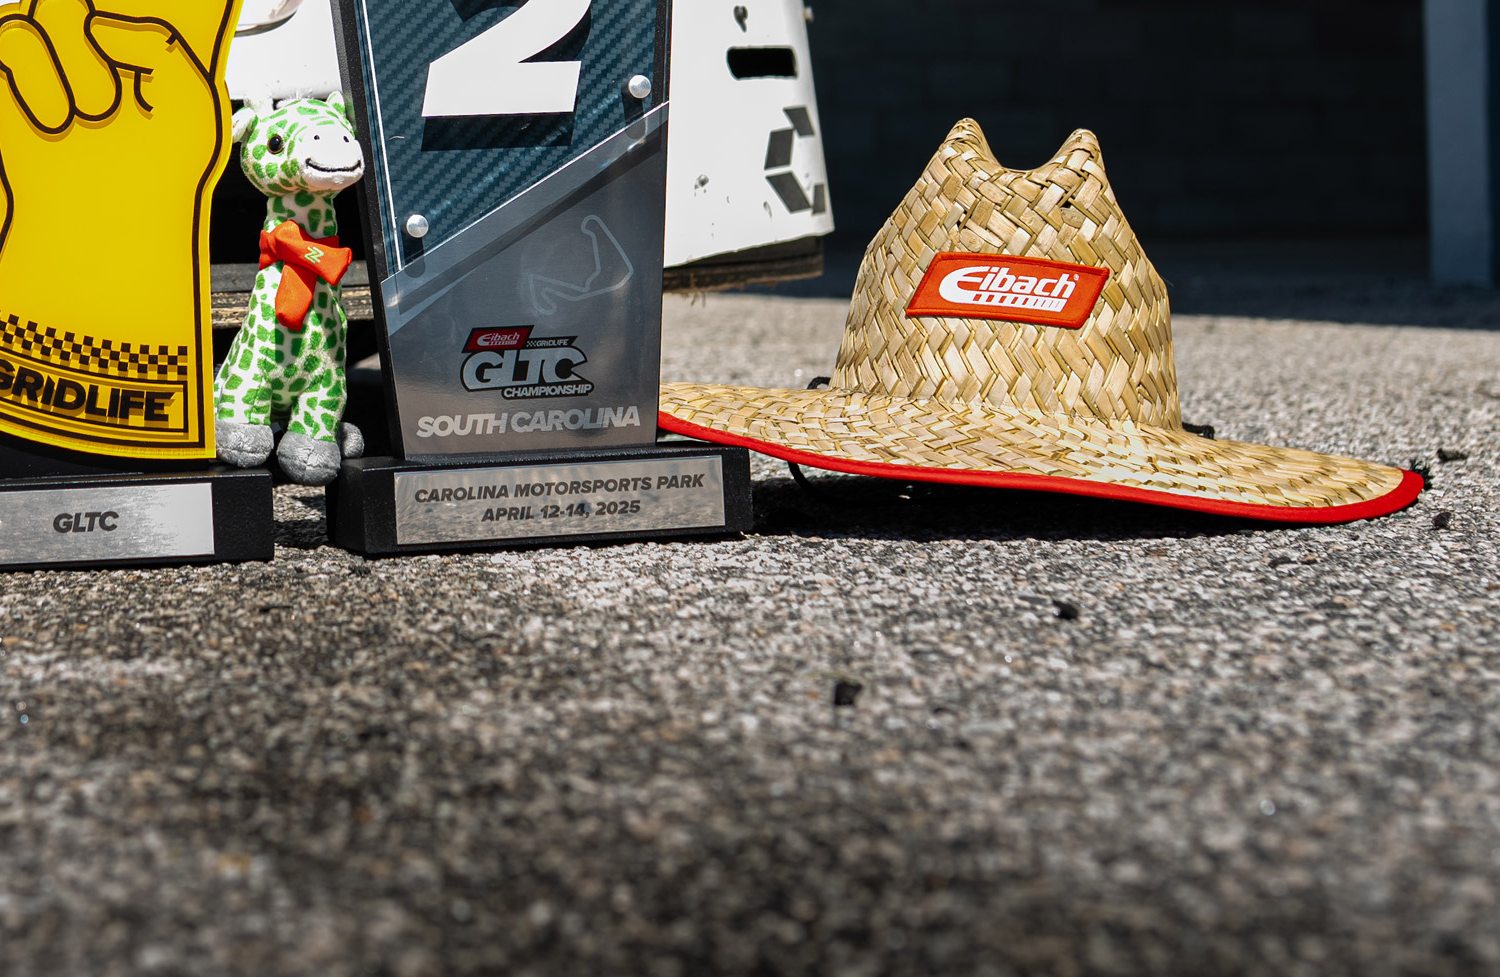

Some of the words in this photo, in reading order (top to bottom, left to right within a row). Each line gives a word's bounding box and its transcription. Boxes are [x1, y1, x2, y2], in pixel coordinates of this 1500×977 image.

[477, 332, 520, 346] Eibach
[536, 338, 569, 347] GRIDLIFE
[463, 347, 586, 390] GLTC
[503, 383, 592, 398] CHAMPIONSHIP
[416, 413, 508, 437] SOUTH
[511, 406, 640, 433] CAROLINA
[415, 484, 508, 503] CAROLINA
[514, 477, 652, 498] MOTORSPORTS
[656, 474, 705, 489] PARK
[53, 511, 119, 533] GLTC
[482, 506, 534, 522] APRIL
[540, 502, 590, 519] 12-14,
[595, 500, 641, 515] 2025
